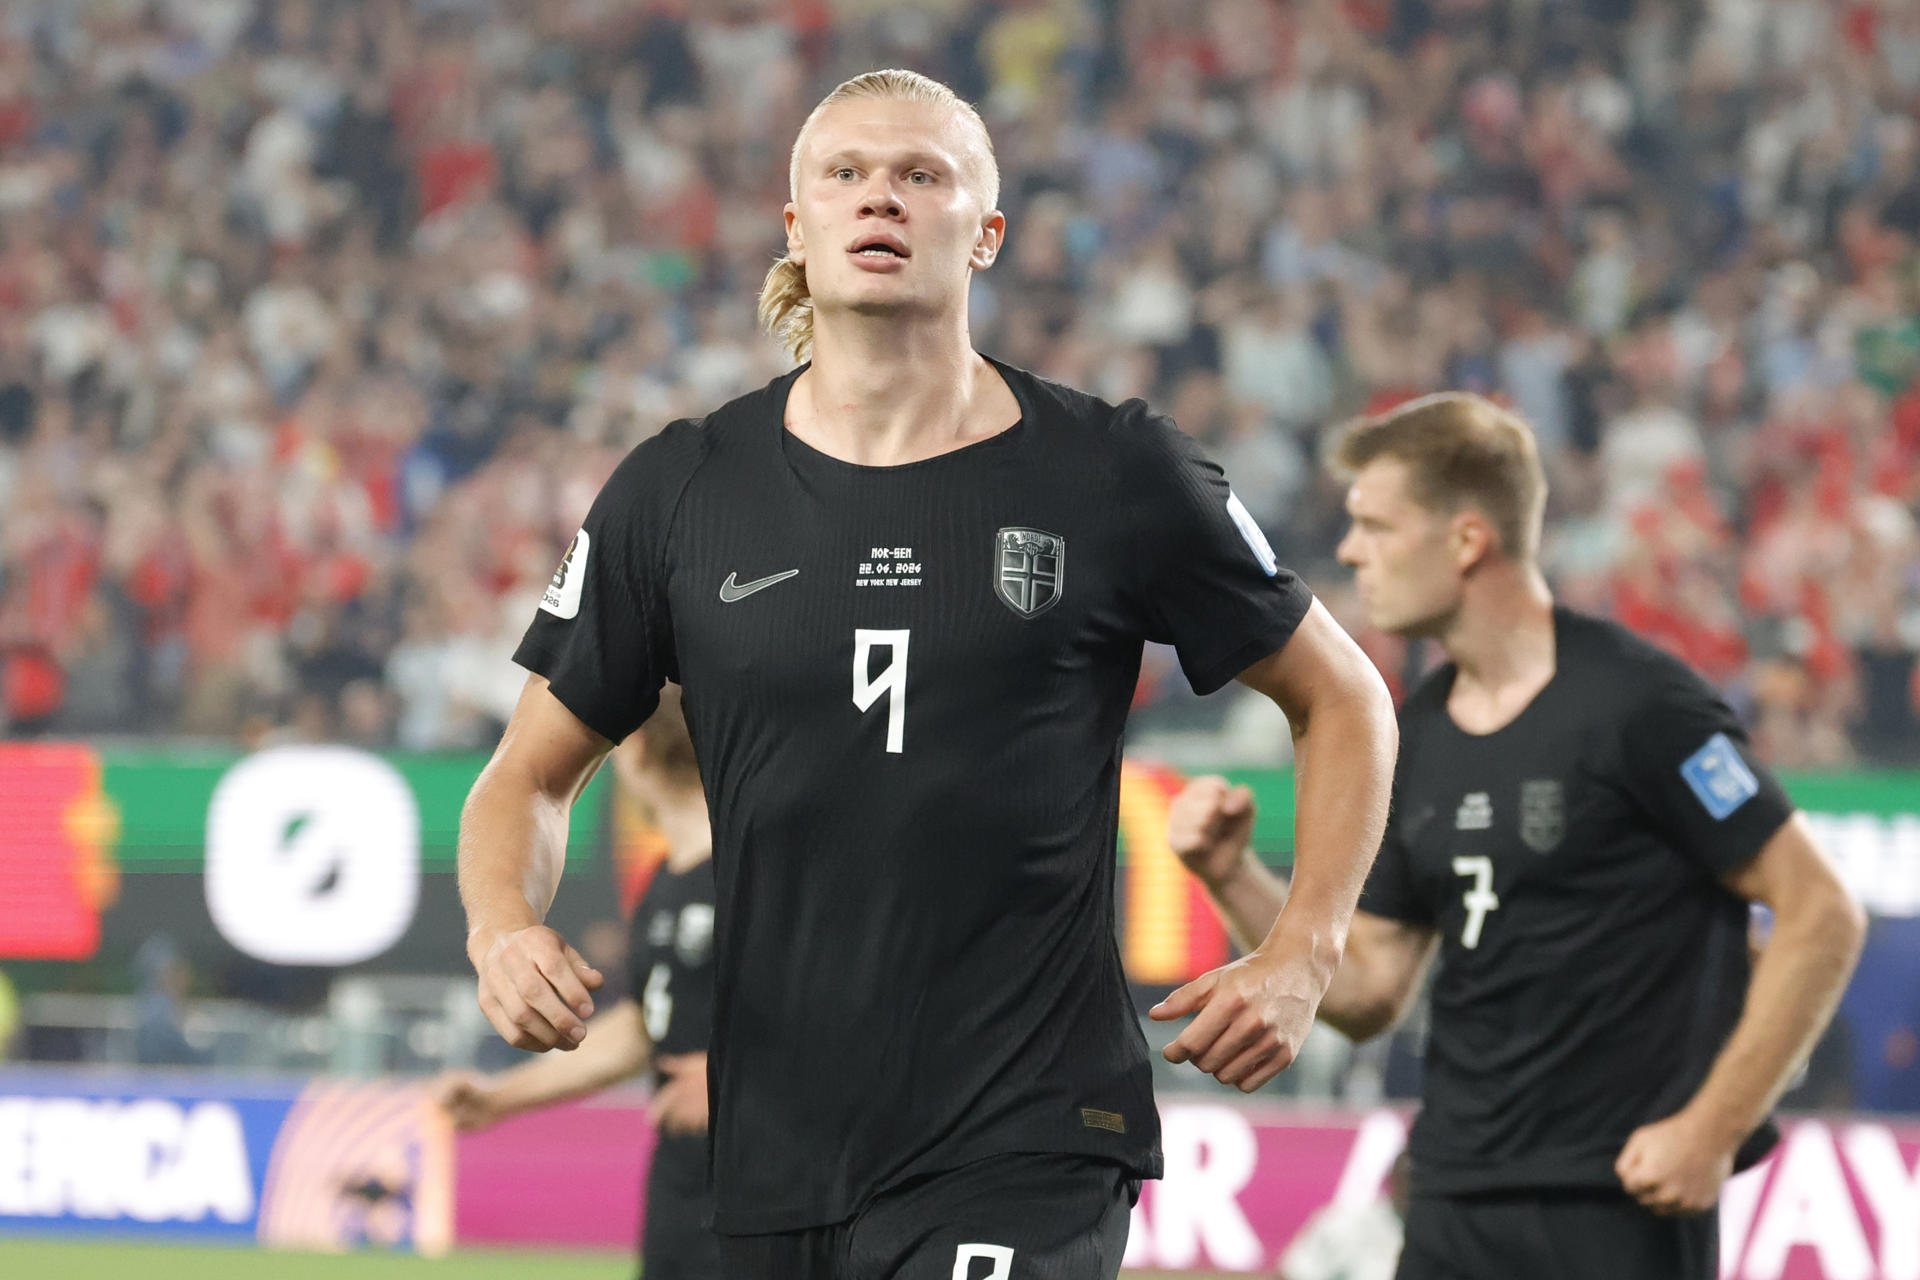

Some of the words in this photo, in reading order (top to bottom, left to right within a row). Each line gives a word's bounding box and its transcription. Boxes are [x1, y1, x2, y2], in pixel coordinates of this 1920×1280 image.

[871, 547, 912, 559] NOR-SEN
[855, 579, 869, 587] NEW
[870, 579, 885, 587] YORK
[885, 579, 899, 587] NEW
[900, 579, 923, 587] JERSEY
[853, 629, 910, 753] 9
[1453, 856, 1498, 949] 7
